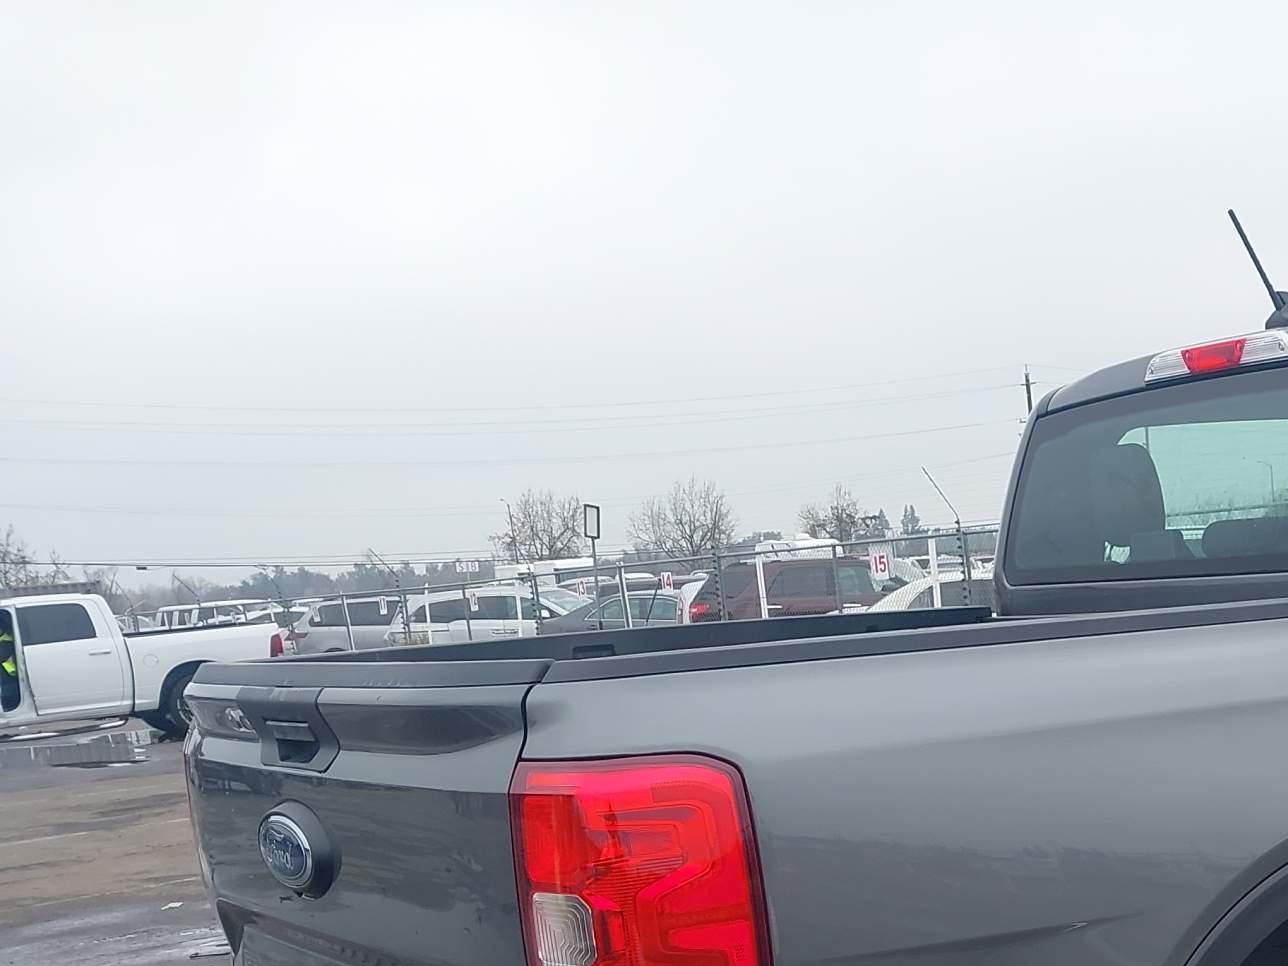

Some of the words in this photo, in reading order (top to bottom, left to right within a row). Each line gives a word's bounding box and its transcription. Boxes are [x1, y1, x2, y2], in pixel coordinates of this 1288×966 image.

[873, 554, 887, 573] 15
[576, 580, 586, 597] 13
[661, 573, 673, 590] 14
[265, 828, 294, 870] Ford
